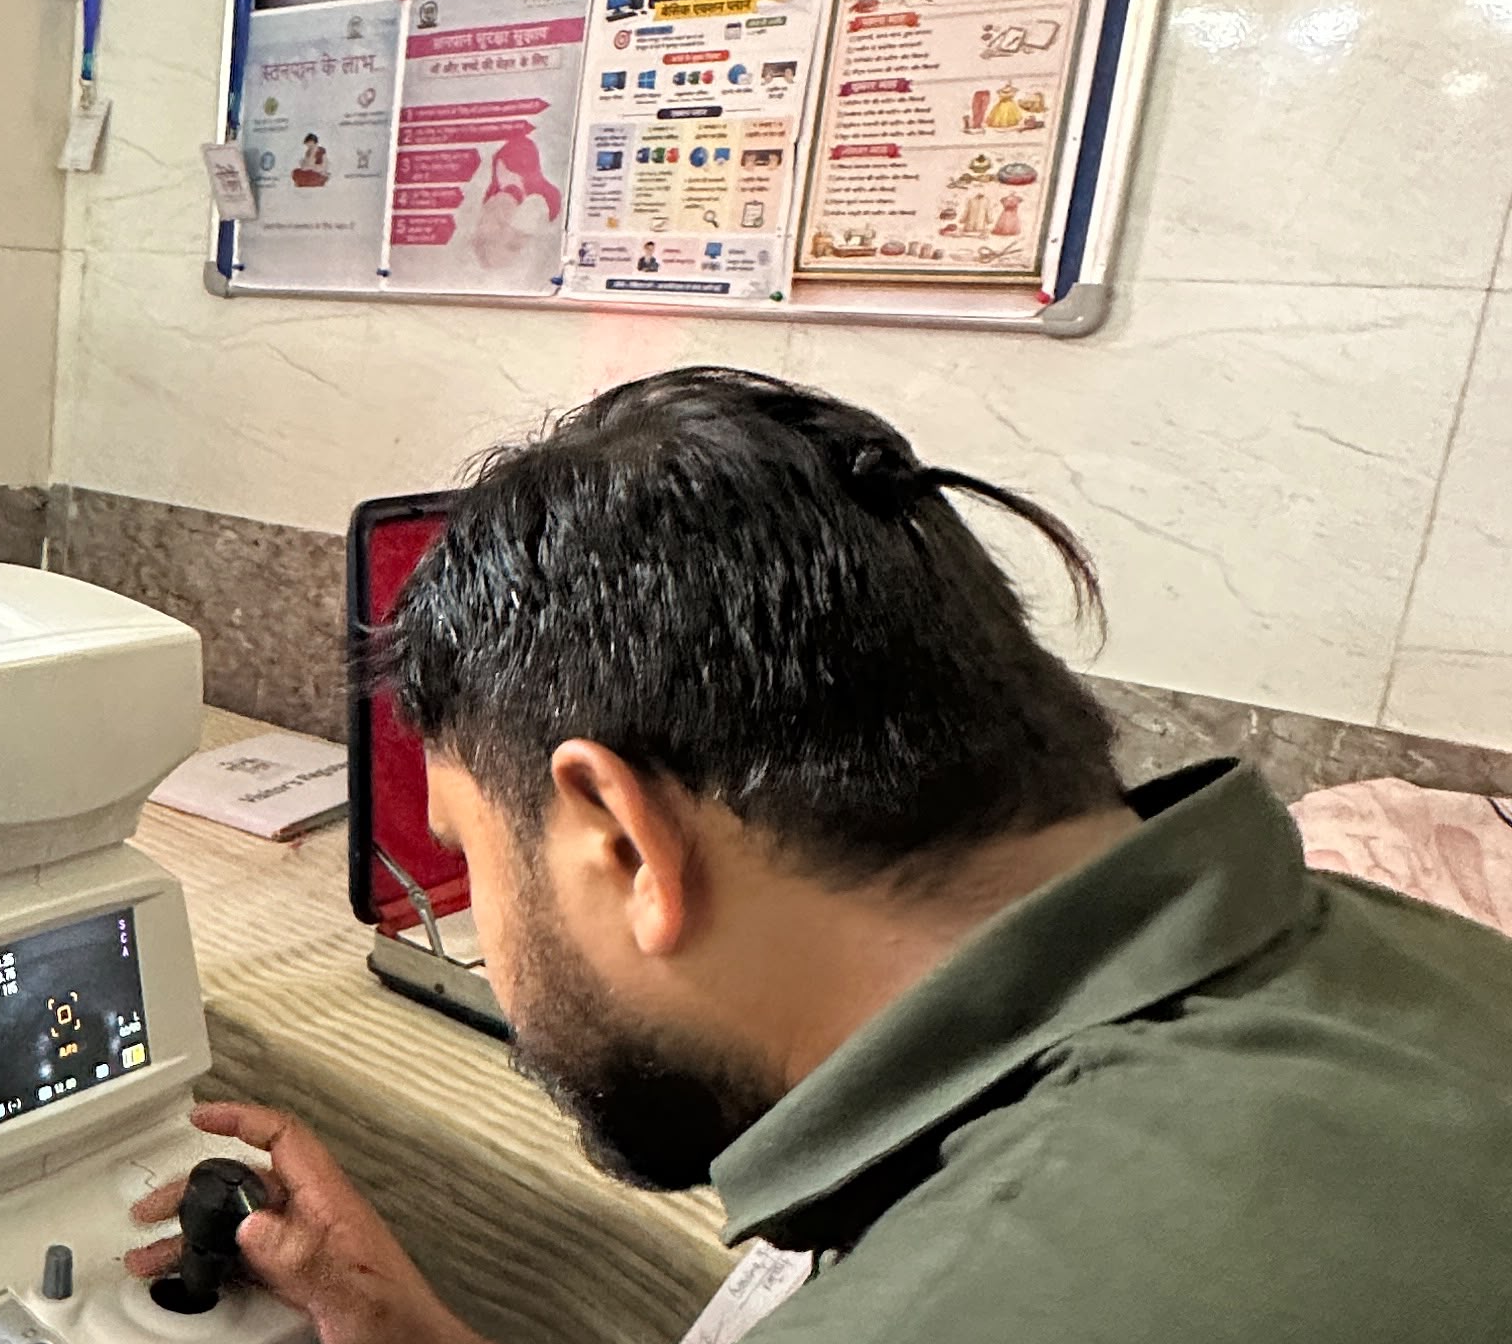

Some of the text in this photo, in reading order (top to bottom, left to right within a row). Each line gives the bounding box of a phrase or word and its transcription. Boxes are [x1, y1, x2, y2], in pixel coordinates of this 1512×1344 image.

[320, 52, 338, 76] के
[396, 219, 407, 234] 5
[118, 919, 126, 931] S
[120, 932, 128, 944] C
[122, 945, 129, 957] A
